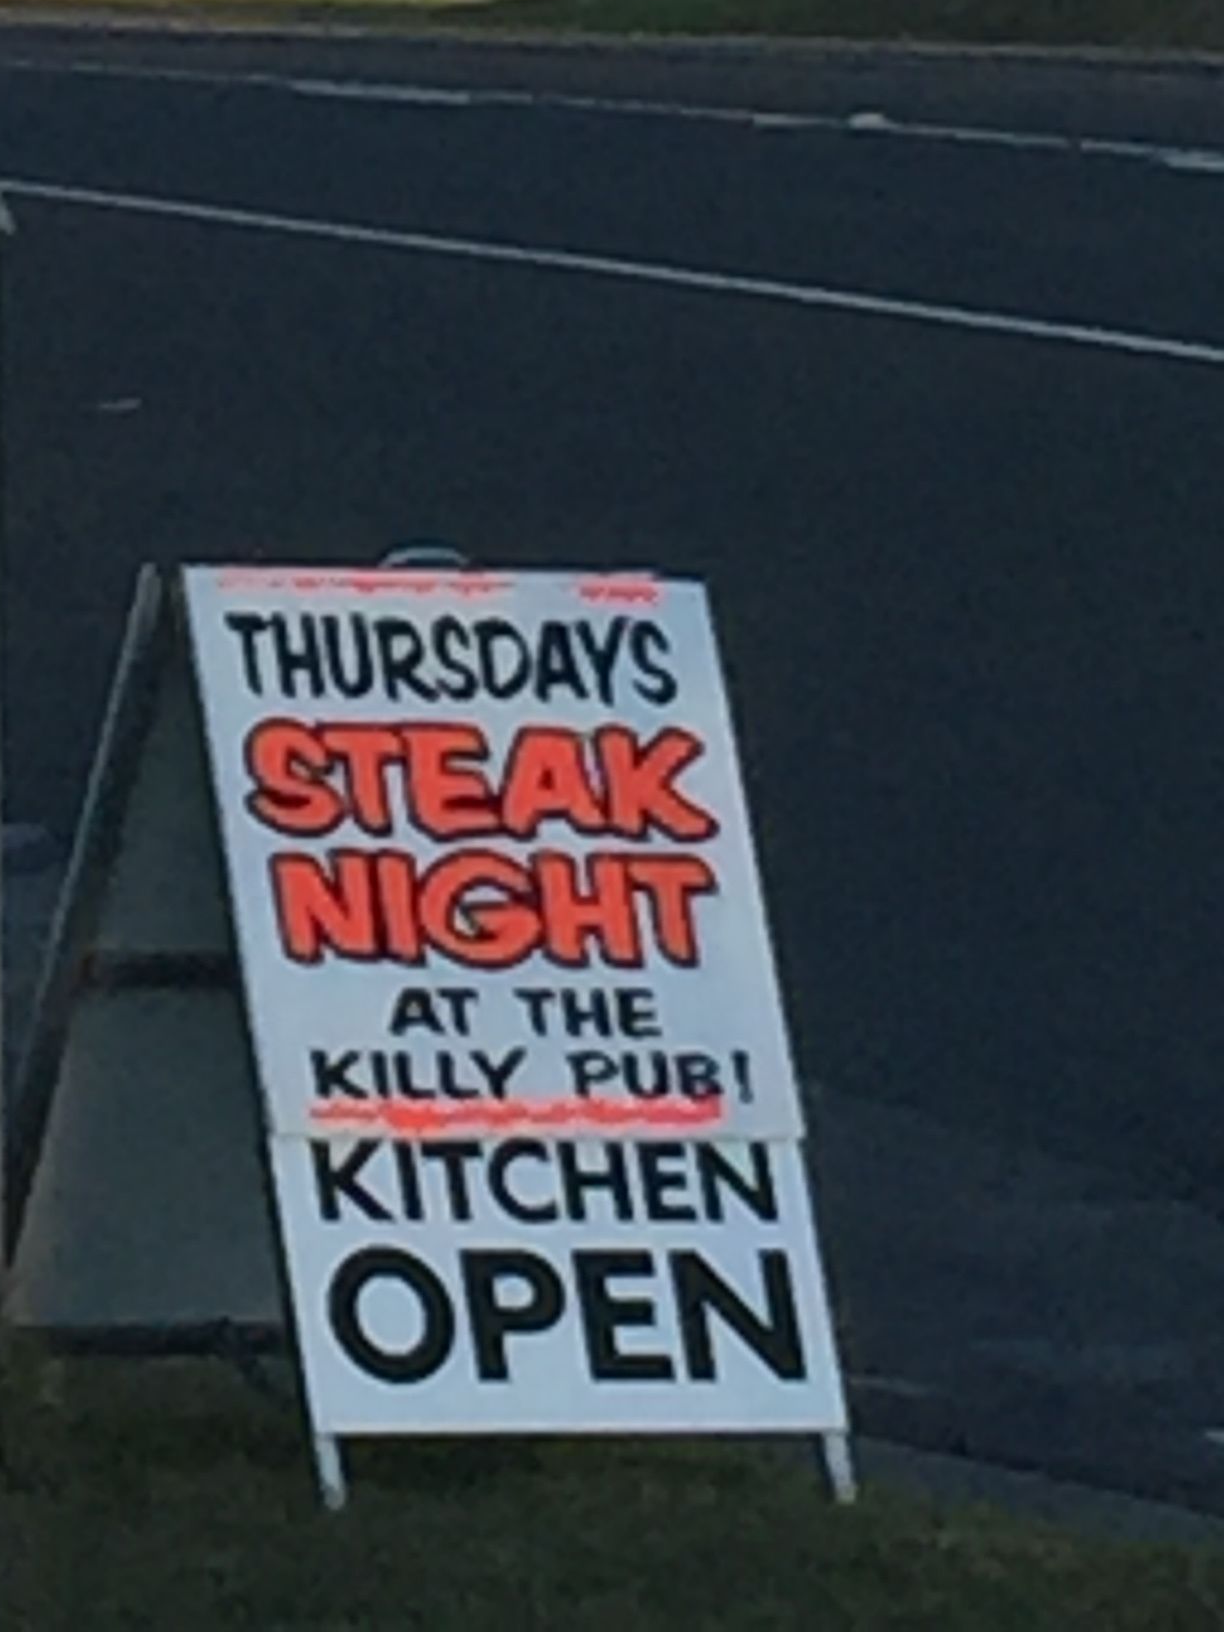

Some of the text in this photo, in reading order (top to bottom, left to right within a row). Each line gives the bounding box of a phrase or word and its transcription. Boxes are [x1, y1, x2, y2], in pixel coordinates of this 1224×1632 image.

[225, 614, 677, 704] THURSDAYS
[244, 719, 717, 842] STEAK
[271, 851, 716, 967] NIGHT
[390, 989, 660, 1037] AT THE
[310, 1050, 753, 1103] KILLY PUB!
[316, 1139, 778, 1223] KITCHEN
[328, 1247, 806, 1384] OPEN
